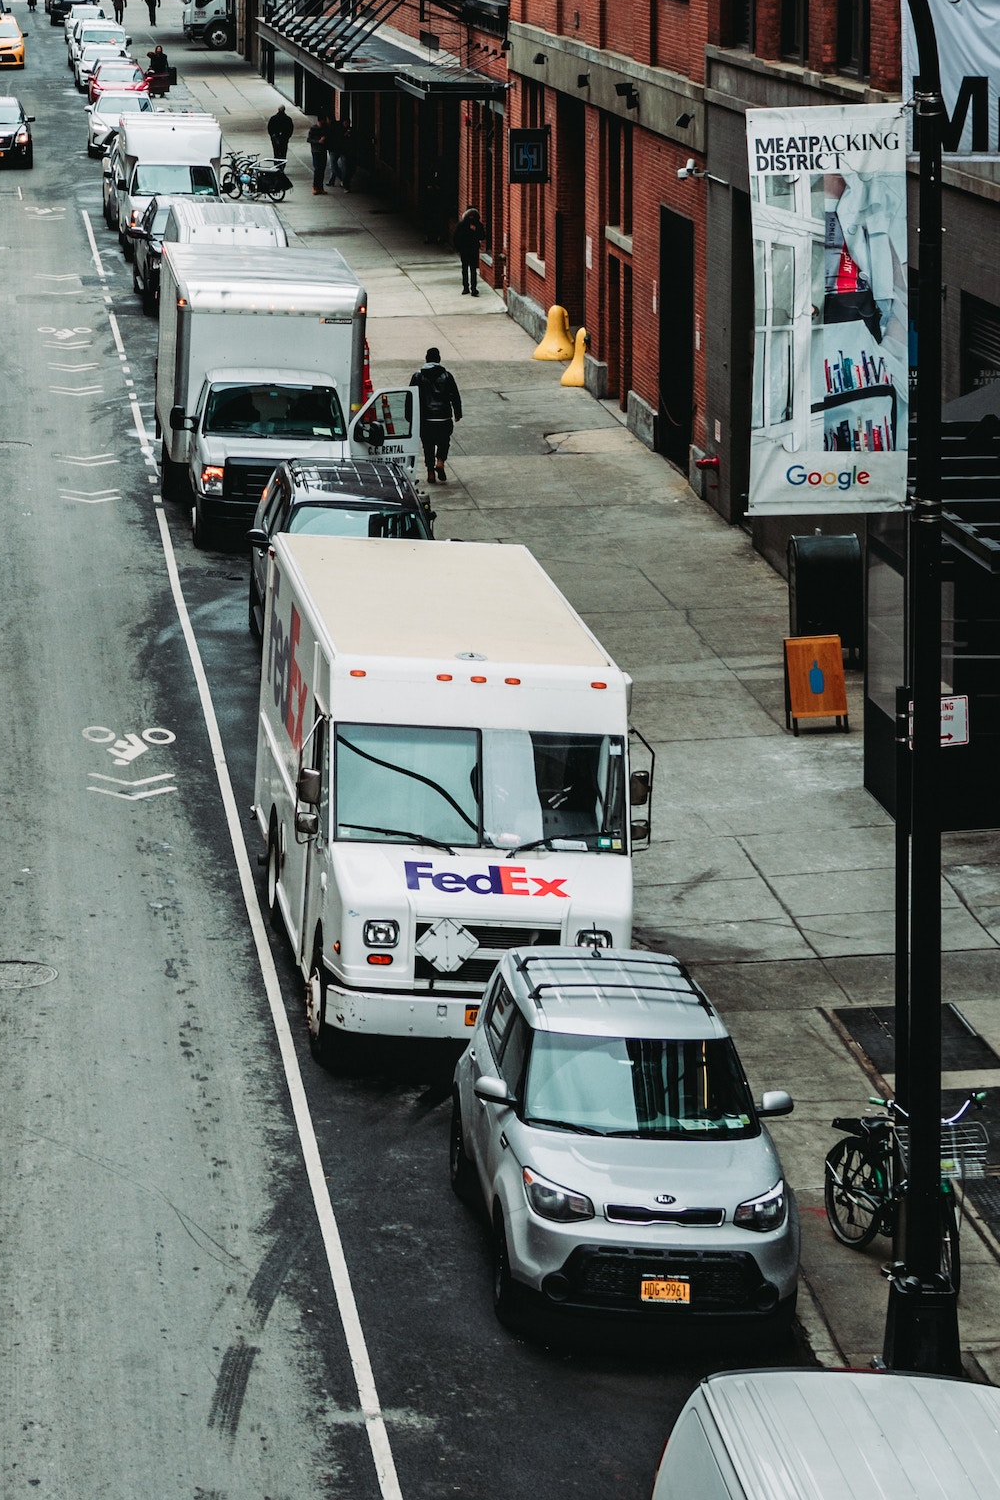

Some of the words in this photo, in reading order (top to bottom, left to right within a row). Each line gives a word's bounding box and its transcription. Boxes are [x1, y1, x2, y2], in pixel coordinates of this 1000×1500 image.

[912, 76, 1000, 152] M
[754, 132, 900, 155] MEATPACKING
[756, 152, 846, 171] DISTRICT
[382, 445, 404, 455] RENTAL
[786, 465, 870, 490] Google
[267, 561, 308, 752] FedEx
[941, 702, 954, 711] ING
[403, 861, 571, 898] FedEx
[657, 1195, 674, 1203] KIA
[665, 1283, 686, 1298] 9961
